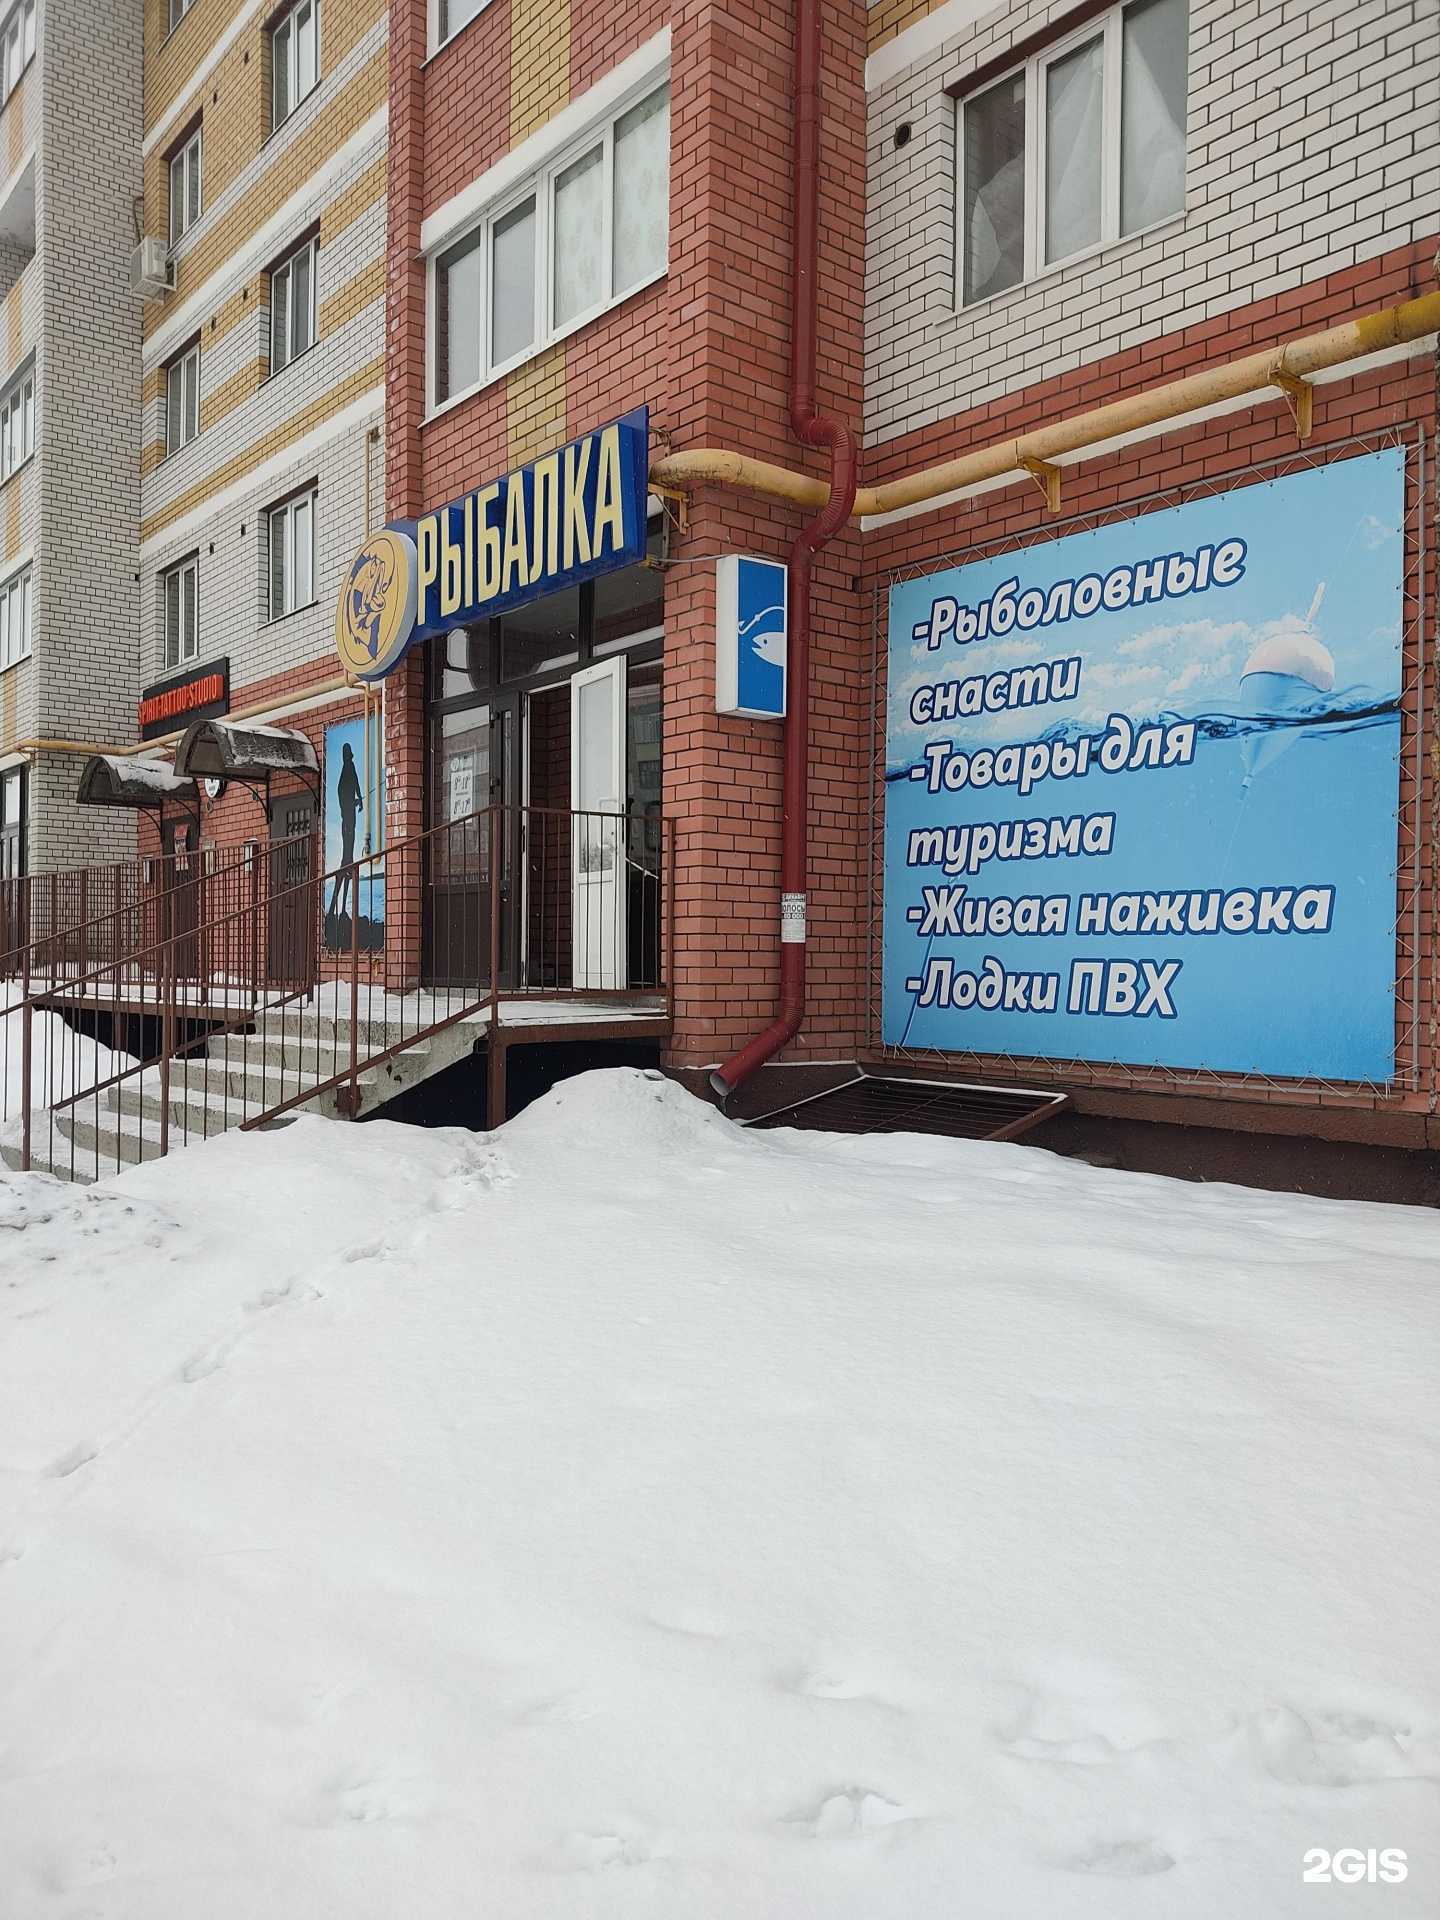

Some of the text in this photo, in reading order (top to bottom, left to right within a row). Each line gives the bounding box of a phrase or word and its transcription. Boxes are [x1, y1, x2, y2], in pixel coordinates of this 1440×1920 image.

[417, 423, 624, 626] РЫБАЛКА
[912, 538, 1246, 649] -Рыболовные
[910, 656, 1081, 723] снасти
[910, 713, 1198, 795] -Товары для
[907, 812, 1116, 876] туризма
[907, 885, 1336, 936] -Живая наживка
[906, 955, 1183, 1019] -Лодки ПВХ
